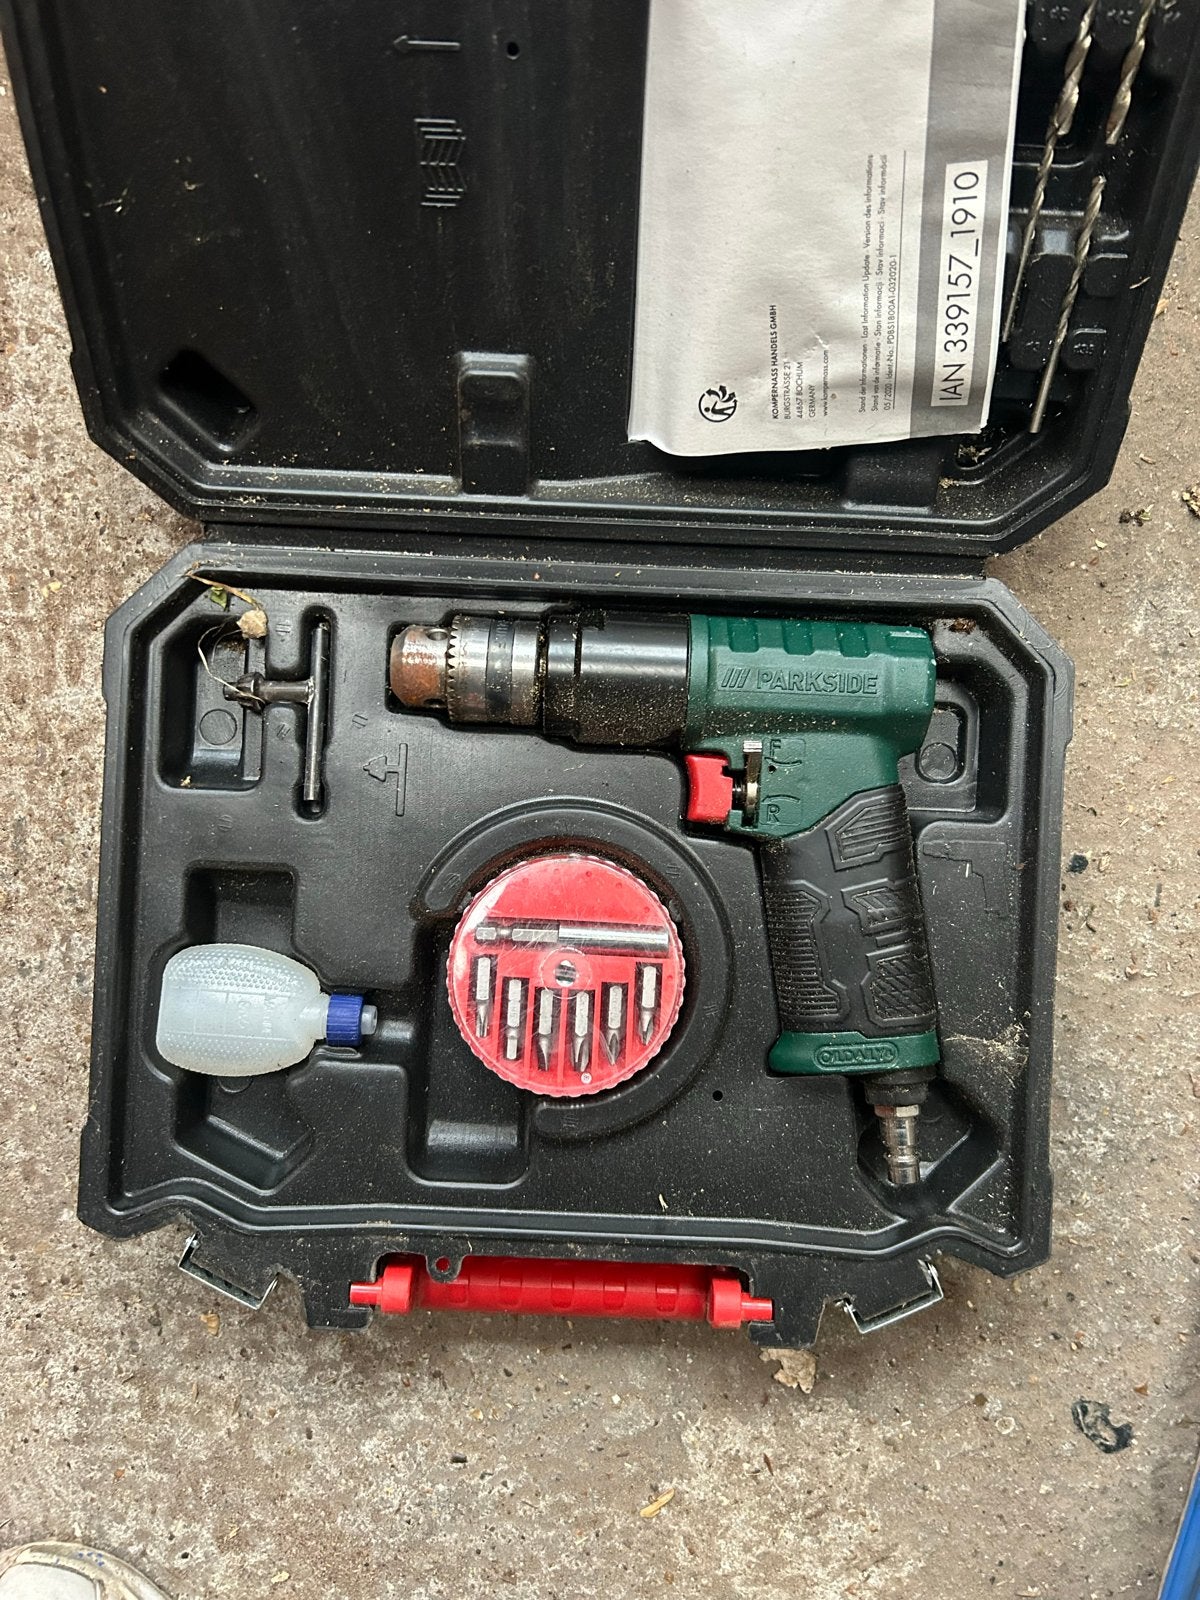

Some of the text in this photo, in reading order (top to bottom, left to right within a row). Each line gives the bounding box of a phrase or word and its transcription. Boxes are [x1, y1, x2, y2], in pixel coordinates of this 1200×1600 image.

[864, 154, 874, 202] informations
[864, 204, 872, 218] des
[878, 198, 886, 214] Stav
[863, 220, 871, 248] Version
[876, 221, 885, 257] informaci
[862, 255, 871, 281] Update
[875, 260, 883, 276] Stav
[939, 171, 979, 400] IAN 339157_1910
[861, 284, 869, 323] Information
[874, 281, 884, 318] informacji
[874, 320, 882, 336] Stan
[770, 331, 778, 366] HANDELS
[872, 342, 881, 375] informatie
[784, 361, 790, 370] 21
[821, 350, 830, 416] www.kompernass.com
[872, 376, 879, 384] de
[770, 368, 778, 420] KOMPERNASS
[808, 384, 816, 418] GERMANY
[871, 395, 879, 412] Stand
[757, 670, 878, 694] PARKSIDE
[769, 739, 781, 756] F
[768, 804, 780, 822] R
